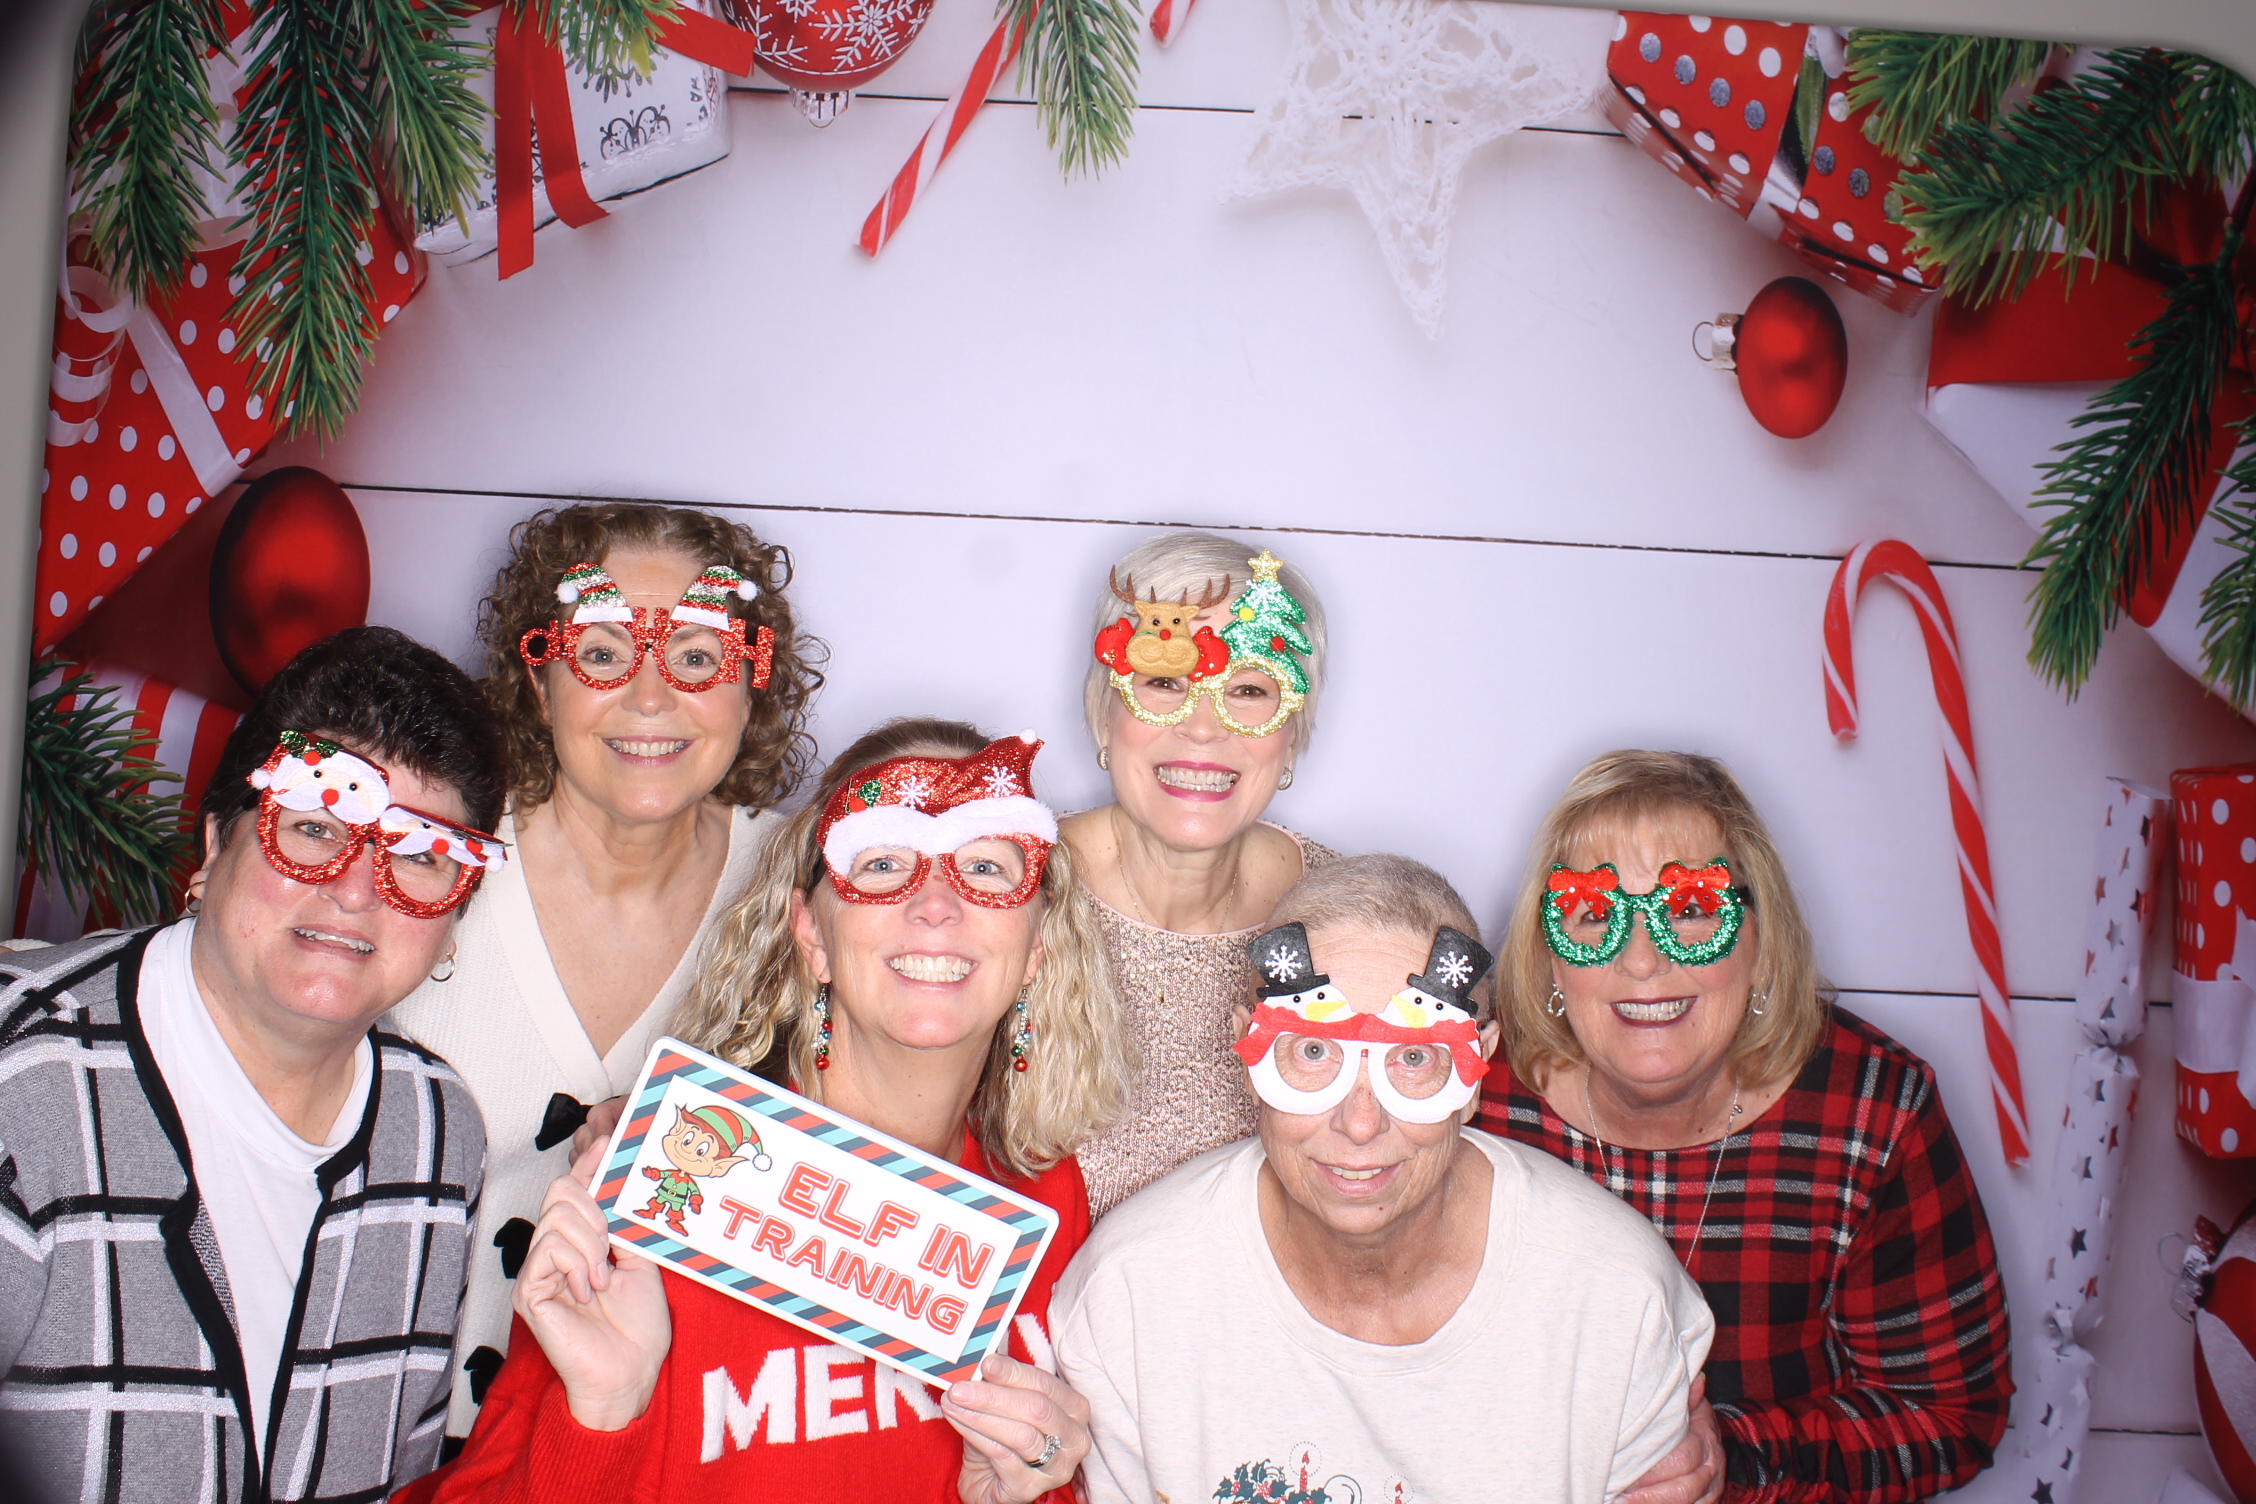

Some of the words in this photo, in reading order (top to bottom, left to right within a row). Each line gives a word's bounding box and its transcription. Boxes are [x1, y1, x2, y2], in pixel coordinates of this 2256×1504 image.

[720, 1195, 968, 1335] TRAINING
[779, 1162, 919, 1247] ELF
[918, 1223, 995, 1289] IN
